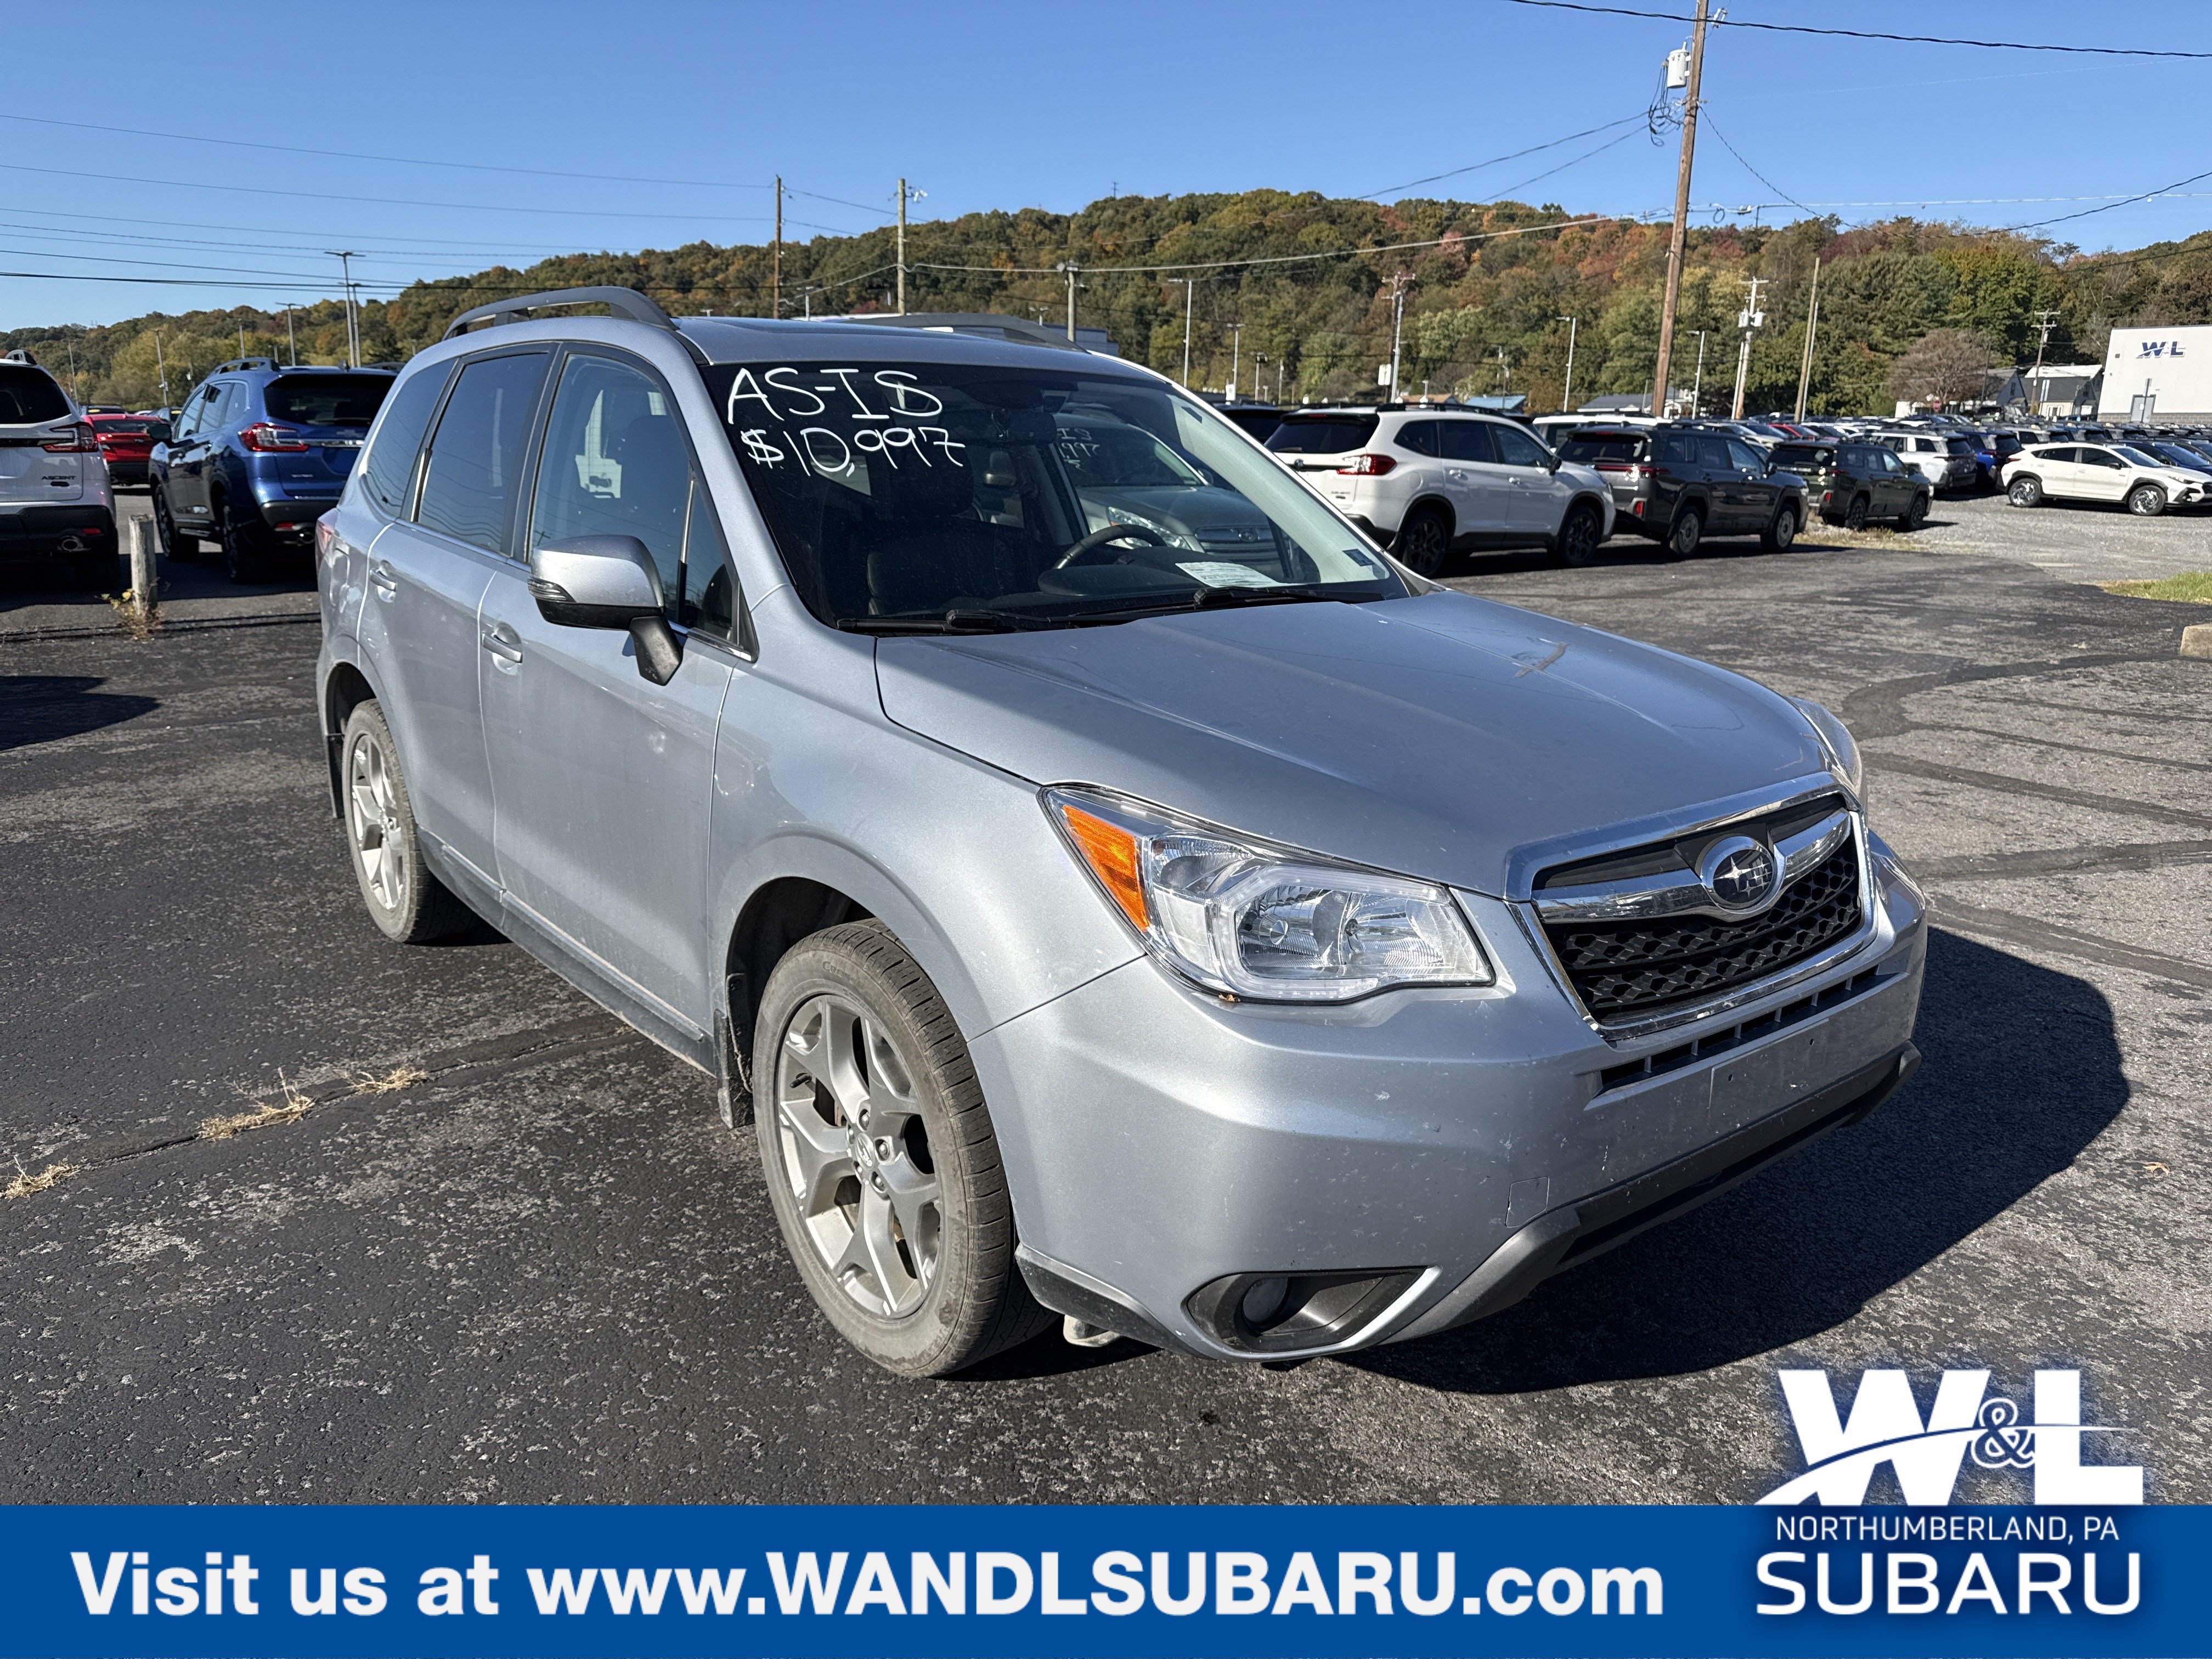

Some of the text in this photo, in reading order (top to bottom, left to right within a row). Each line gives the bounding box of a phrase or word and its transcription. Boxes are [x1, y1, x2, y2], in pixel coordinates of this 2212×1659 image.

[2139, 341, 2184, 357] WL
[727, 367, 943, 425] AS-IS
[741, 426, 966, 477] $10,997
